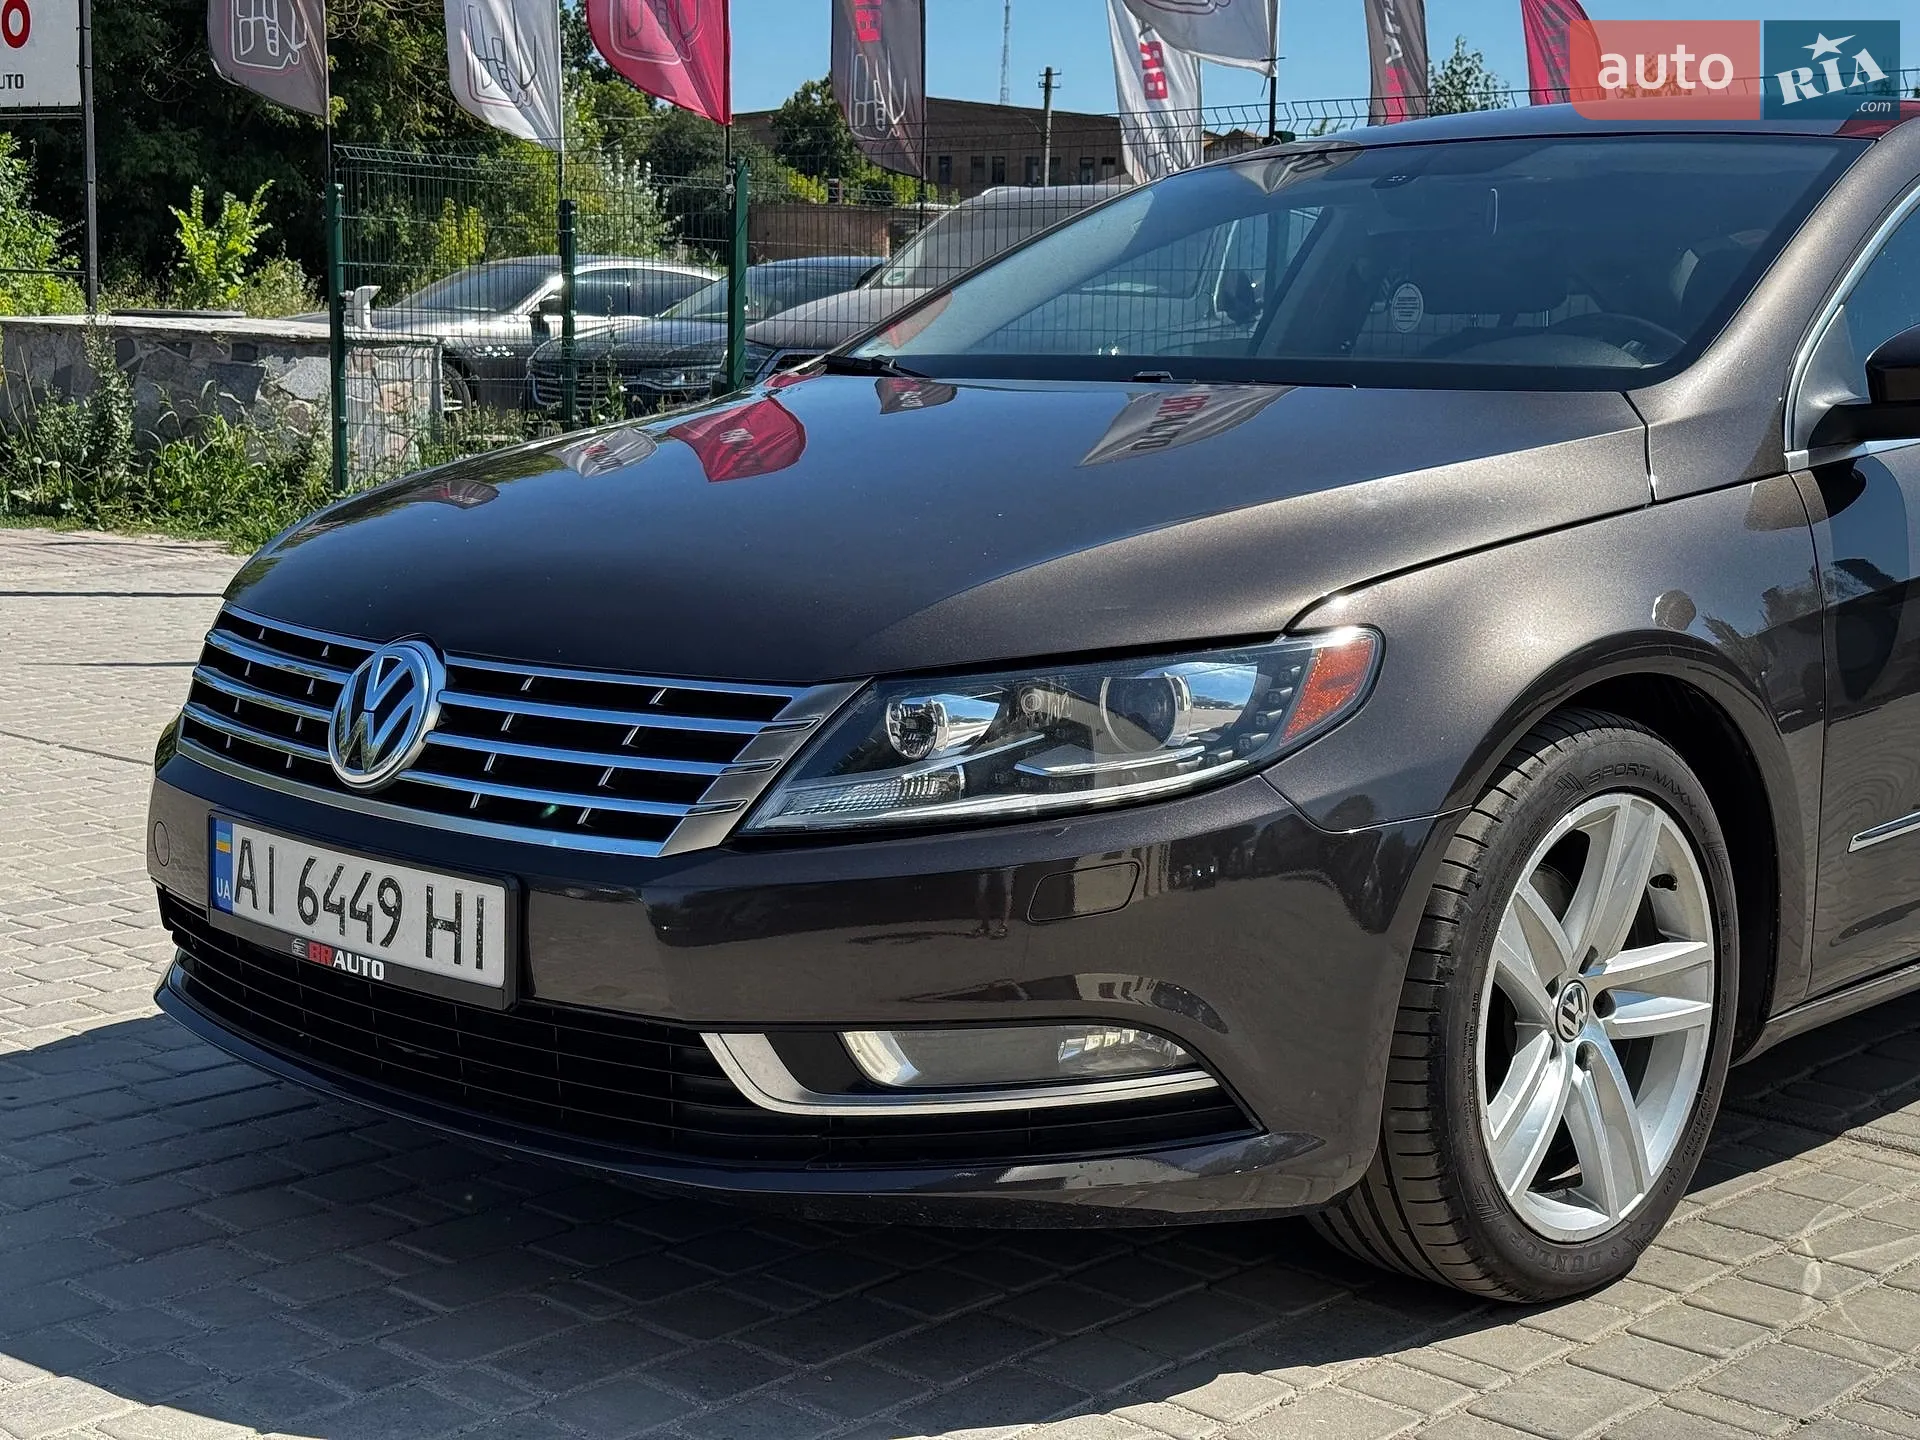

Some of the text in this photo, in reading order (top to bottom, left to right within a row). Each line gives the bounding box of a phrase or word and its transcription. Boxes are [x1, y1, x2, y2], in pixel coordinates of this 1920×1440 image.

[1585, 762, 1651, 787] SPORT
[216, 877, 232, 901] UA
[234, 837, 486, 971] AI 6449 HI
